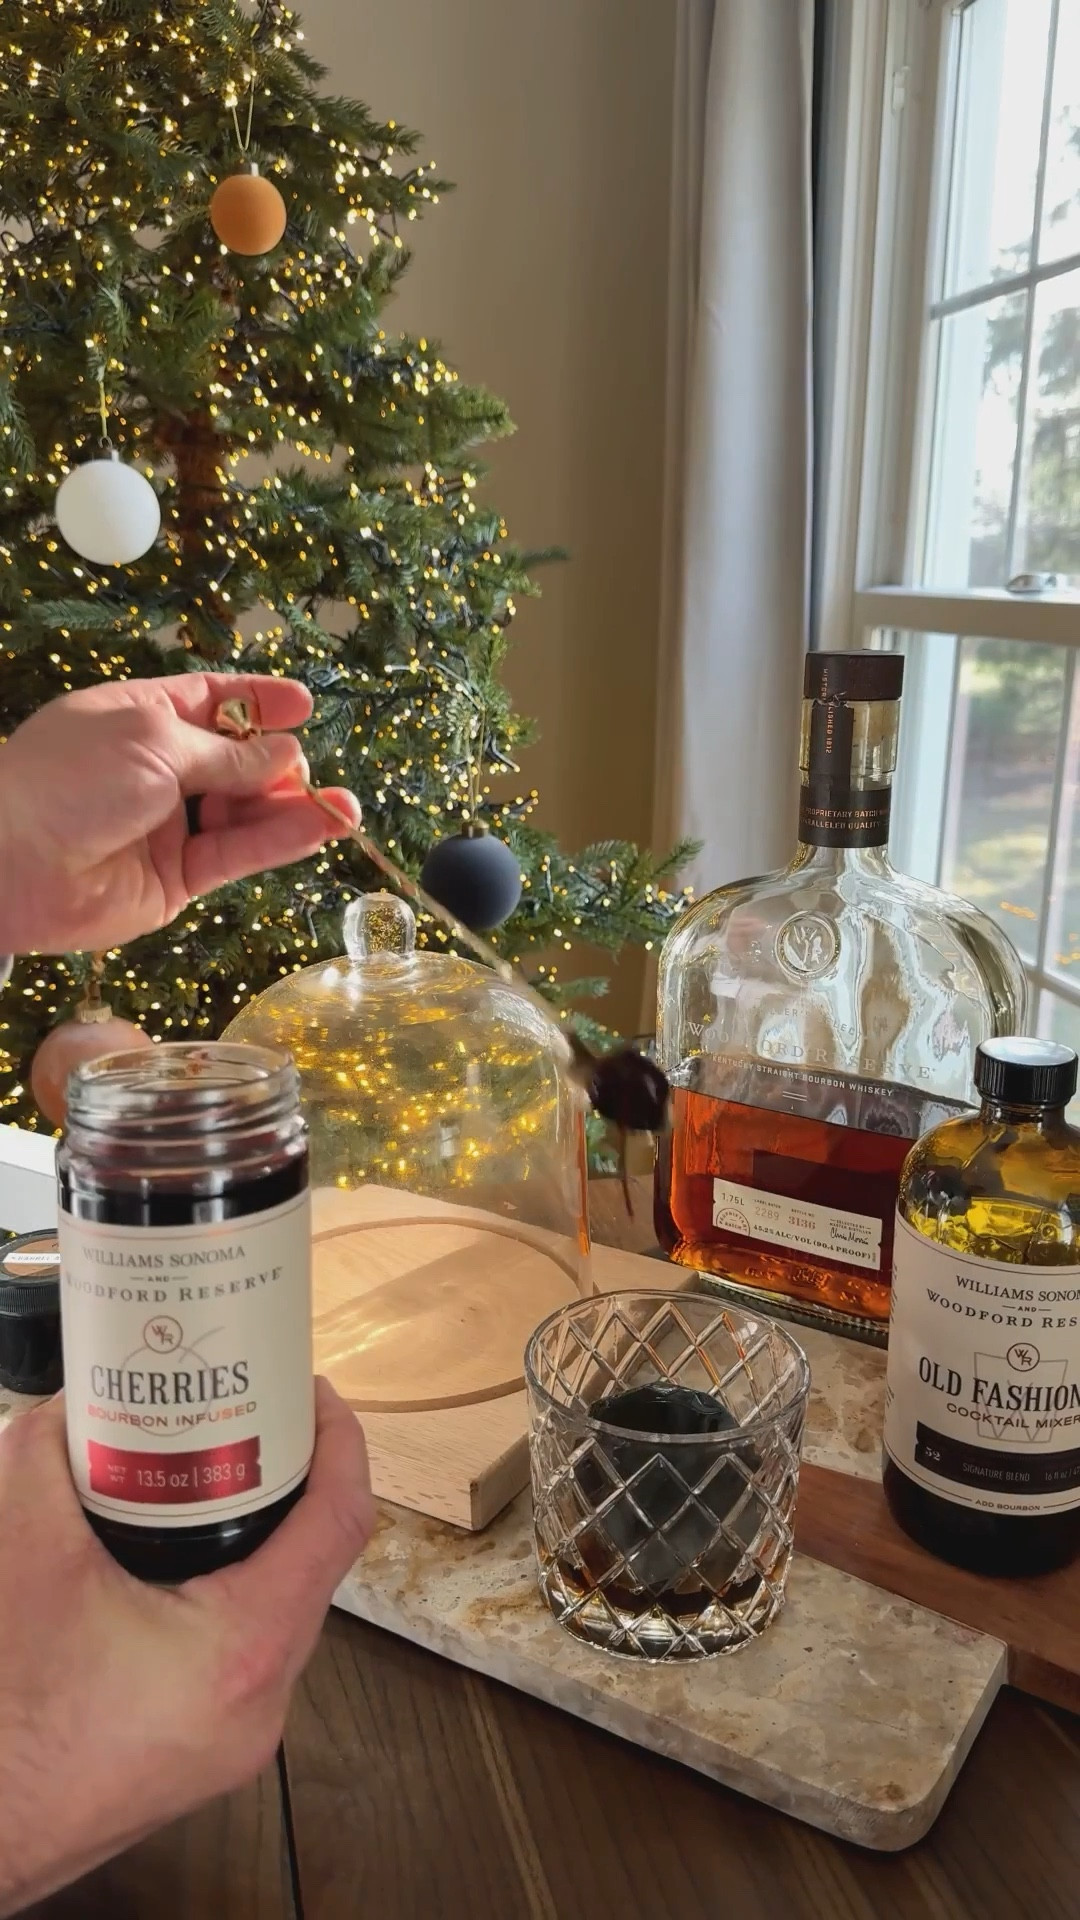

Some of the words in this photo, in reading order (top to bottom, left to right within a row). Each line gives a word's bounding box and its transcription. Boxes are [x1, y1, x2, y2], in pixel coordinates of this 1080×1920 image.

[712, 1055, 753, 1069] KENTUCKY
[757, 1065, 800, 1080] STRAIGHT
[802, 1074, 845, 1089] BOURBON
[849, 1083, 894, 1097] WHISKEY
[721, 1192, 745, 1206] 1.75L
[754, 1206, 780, 1221] 2289
[83, 1247, 164, 1269] WILLIAMS
[169, 1245, 246, 1268] SONOMA
[775, 1230, 812, 1245] ALC/VOL
[813, 1240, 835, 1252] (90.4
[836, 1245, 871, 1260] PROOF)
[179, 1266, 281, 1301] RESERVE
[955, 1275, 1034, 1301] WILLIAMS
[1038, 1289, 1080, 1302] SONO
[926, 1288, 1033, 1327] WOODFORD
[91, 1360, 249, 1405] CHERRIES
[919, 1356, 962, 1397] OLD
[971, 1377, 1080, 1412] FASHION
[87, 1403, 169, 1427] BOURBON
[176, 1401, 257, 1426] INFUSED
[946, 1402, 1030, 1429] COCKTAIL
[1035, 1414, 1080, 1429] MIXER
[137, 1469, 166, 1487] 13.5
[170, 1475, 189, 1487] oz
[203, 1463, 231, 1484] 383
[236, 1463, 246, 1481] g
[962, 1462, 1003, 1481] SIGNATURE
[1005, 1471, 1030, 1482] BLEND
[975, 1500, 995, 1508] ADD
[996, 1503, 1041, 1511] BOURBON
